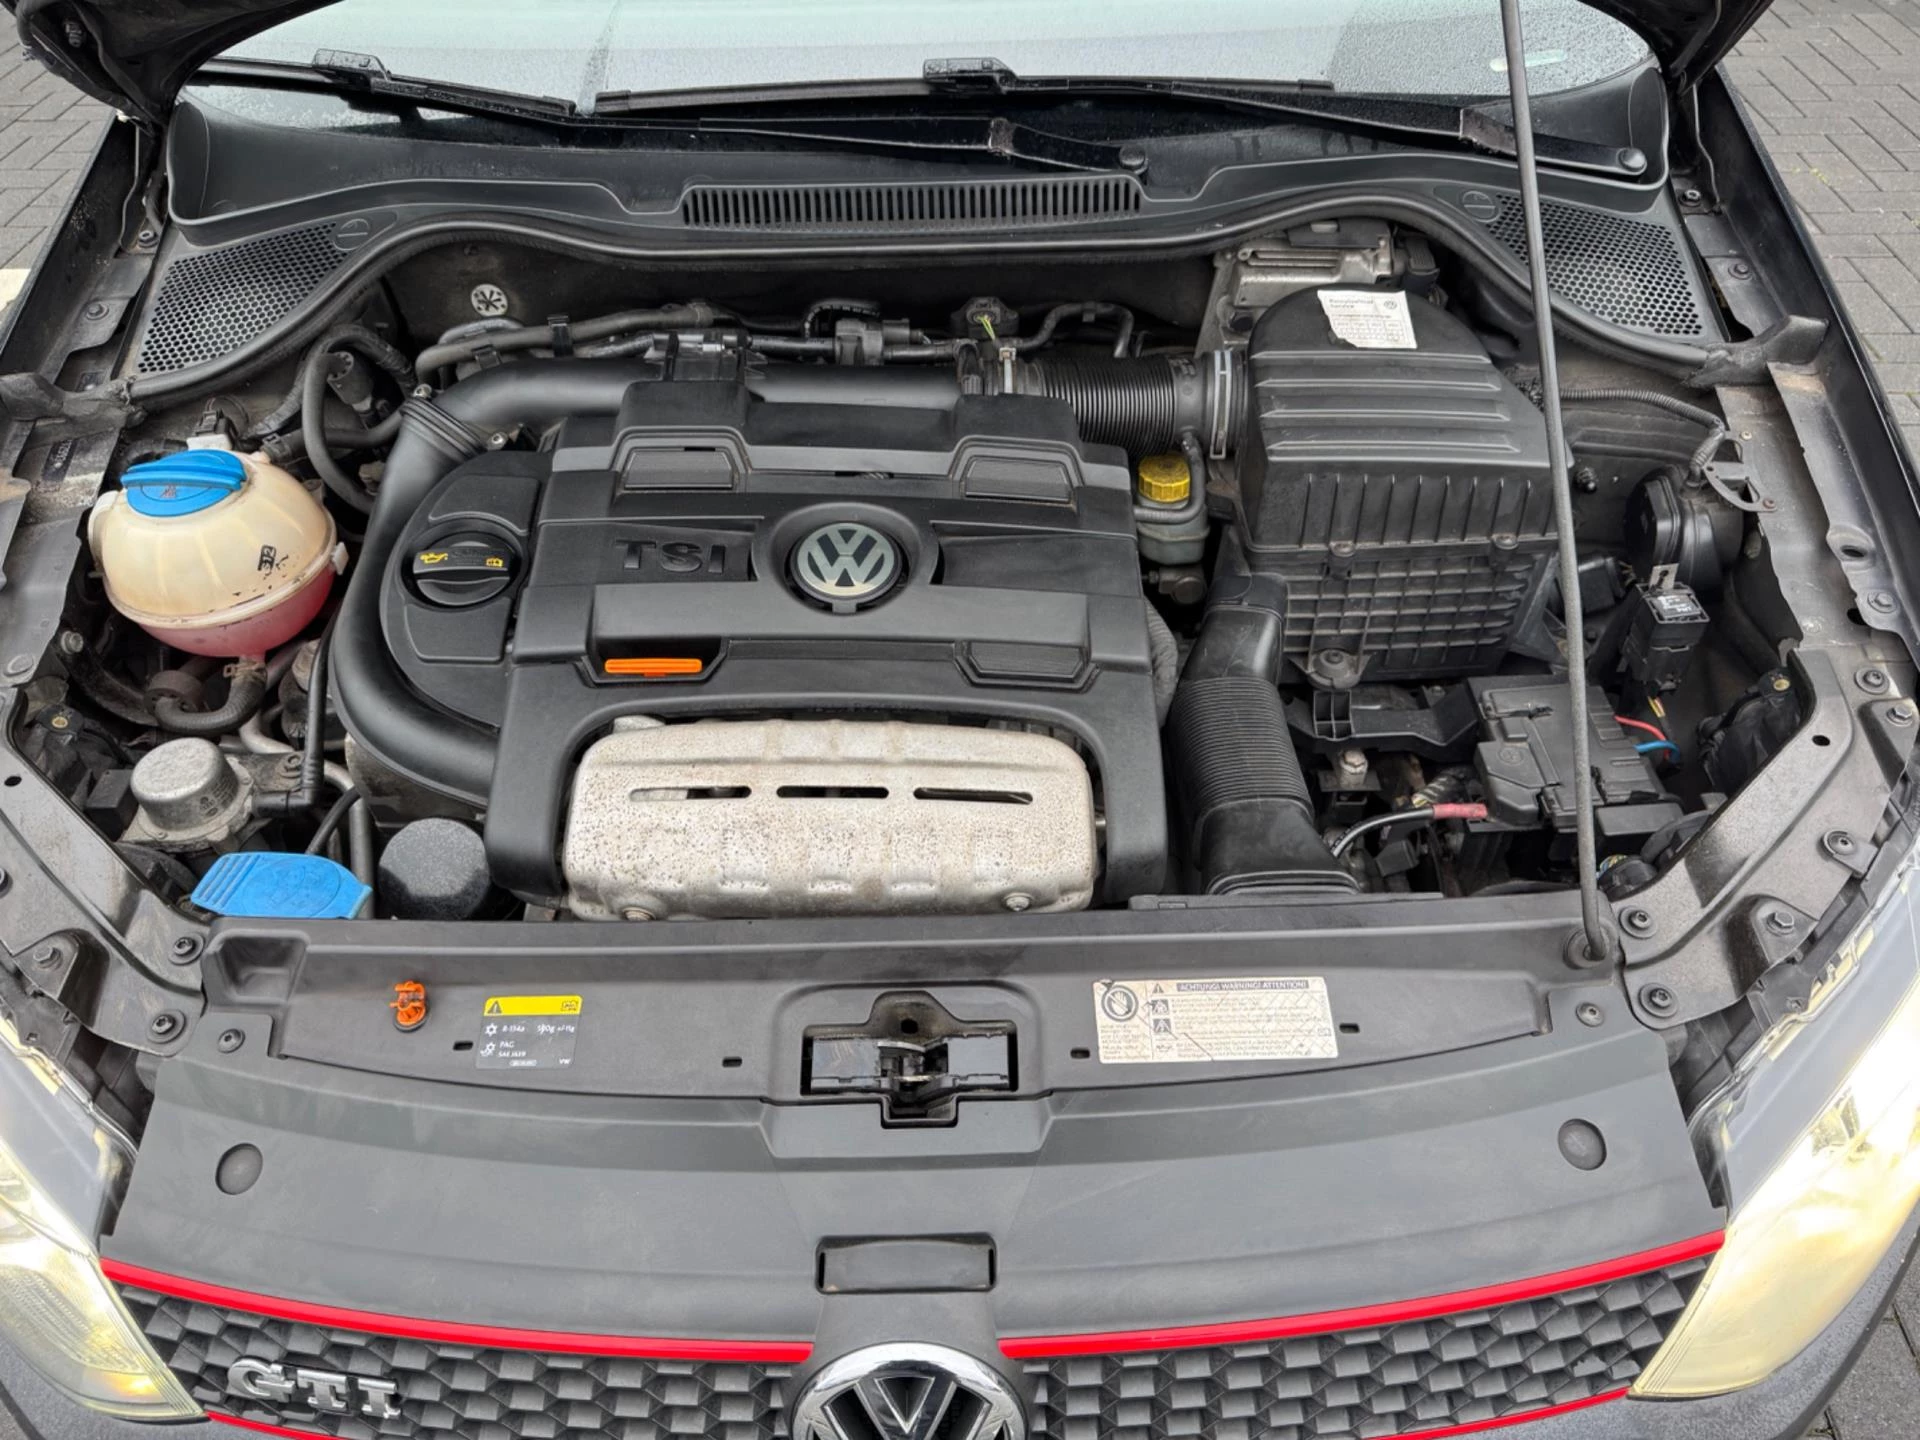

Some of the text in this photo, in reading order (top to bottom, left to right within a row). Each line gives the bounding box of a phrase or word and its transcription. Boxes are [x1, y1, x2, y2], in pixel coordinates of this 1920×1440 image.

[615, 537, 727, 573] TSI
[1221, 982, 1260, 991] WARNING!
[1262, 980, 1307, 989] ATTENTION!
[227, 1357, 401, 1420] GTI
